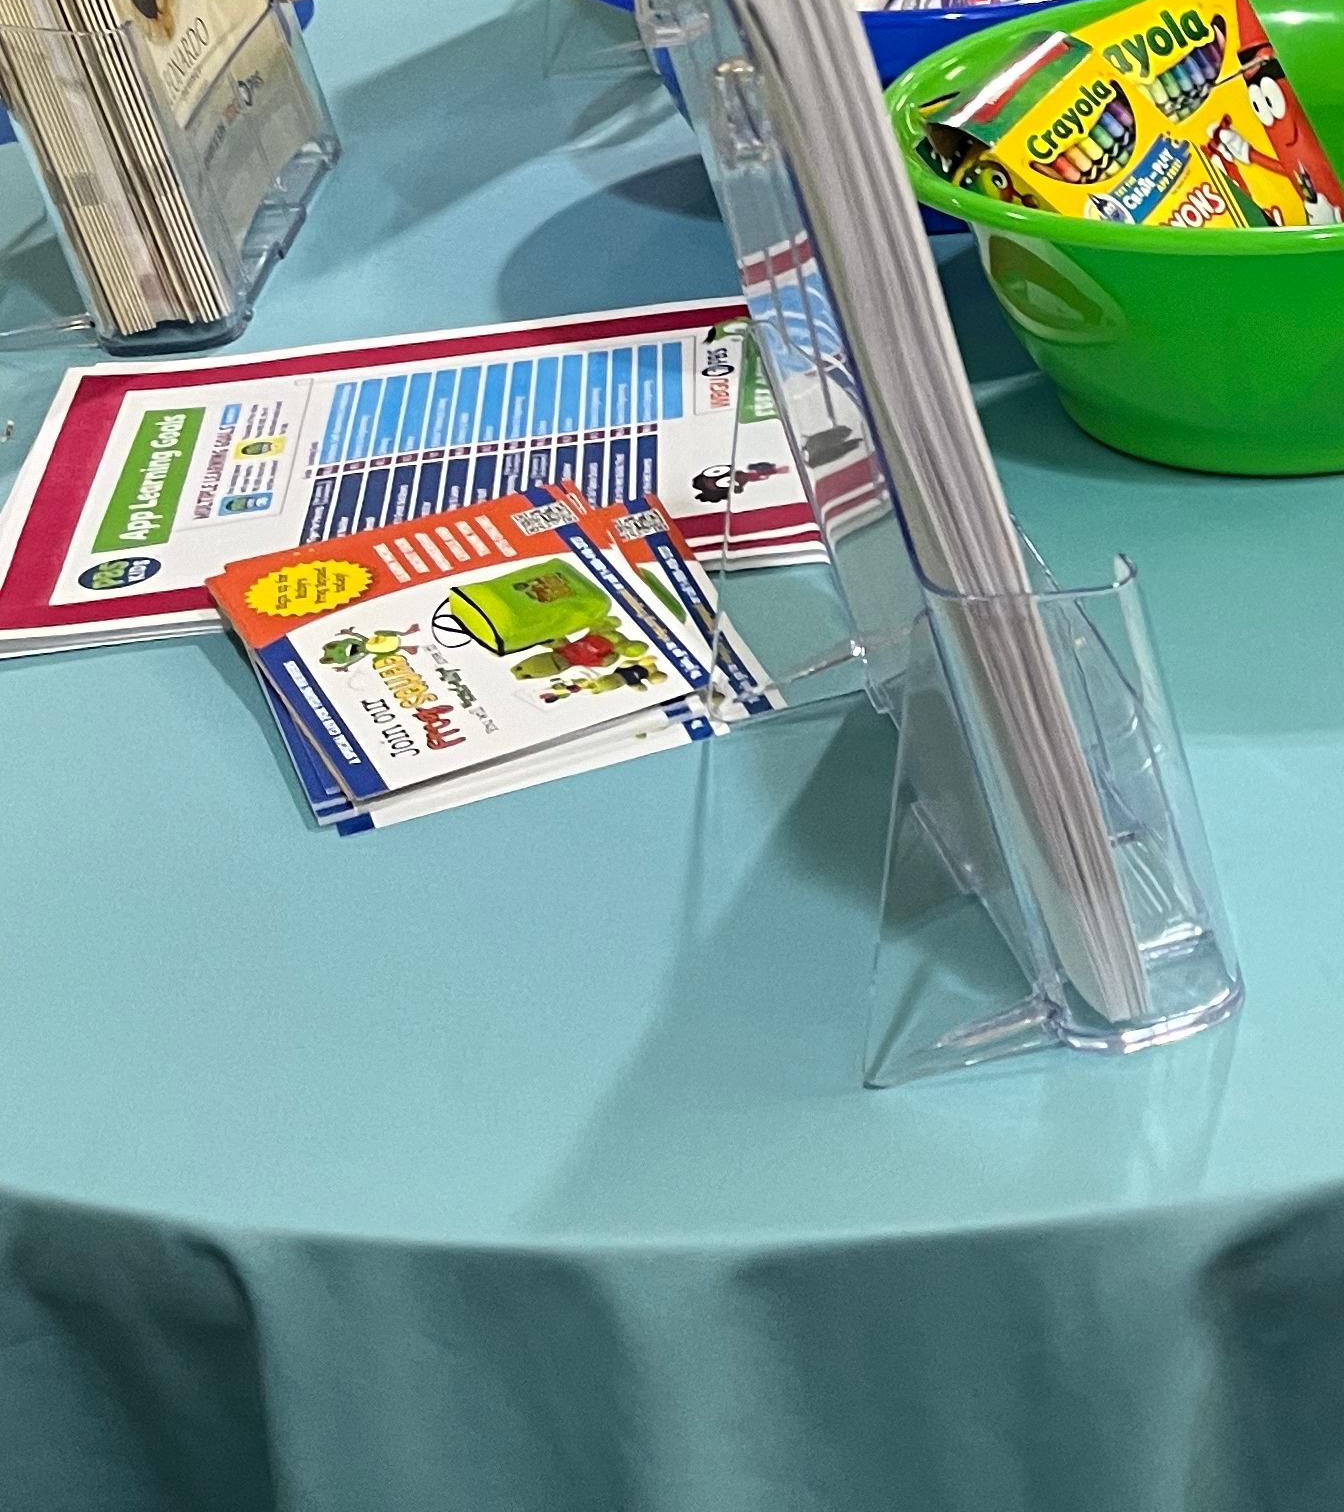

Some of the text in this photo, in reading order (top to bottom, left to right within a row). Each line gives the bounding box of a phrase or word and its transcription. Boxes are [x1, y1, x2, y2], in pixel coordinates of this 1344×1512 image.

[1103, 10, 1209, 78] ayola
[1027, 80, 1112, 159] Crayola
[1168, 182, 1226, 228] YONS
[707, 347, 728, 366] PBS
[214, 424, 236, 450] GOALS
[119, 414, 186, 541] App Learning Goals
[203, 449, 228, 487] LEARNING
[193, 484, 218, 520] MULTIPLE
[92, 559, 129, 589] PBS
[128, 559, 151, 582] KIDS
[372, 655, 466, 750] Frog SQUAD
[361, 698, 420, 758] Join our
